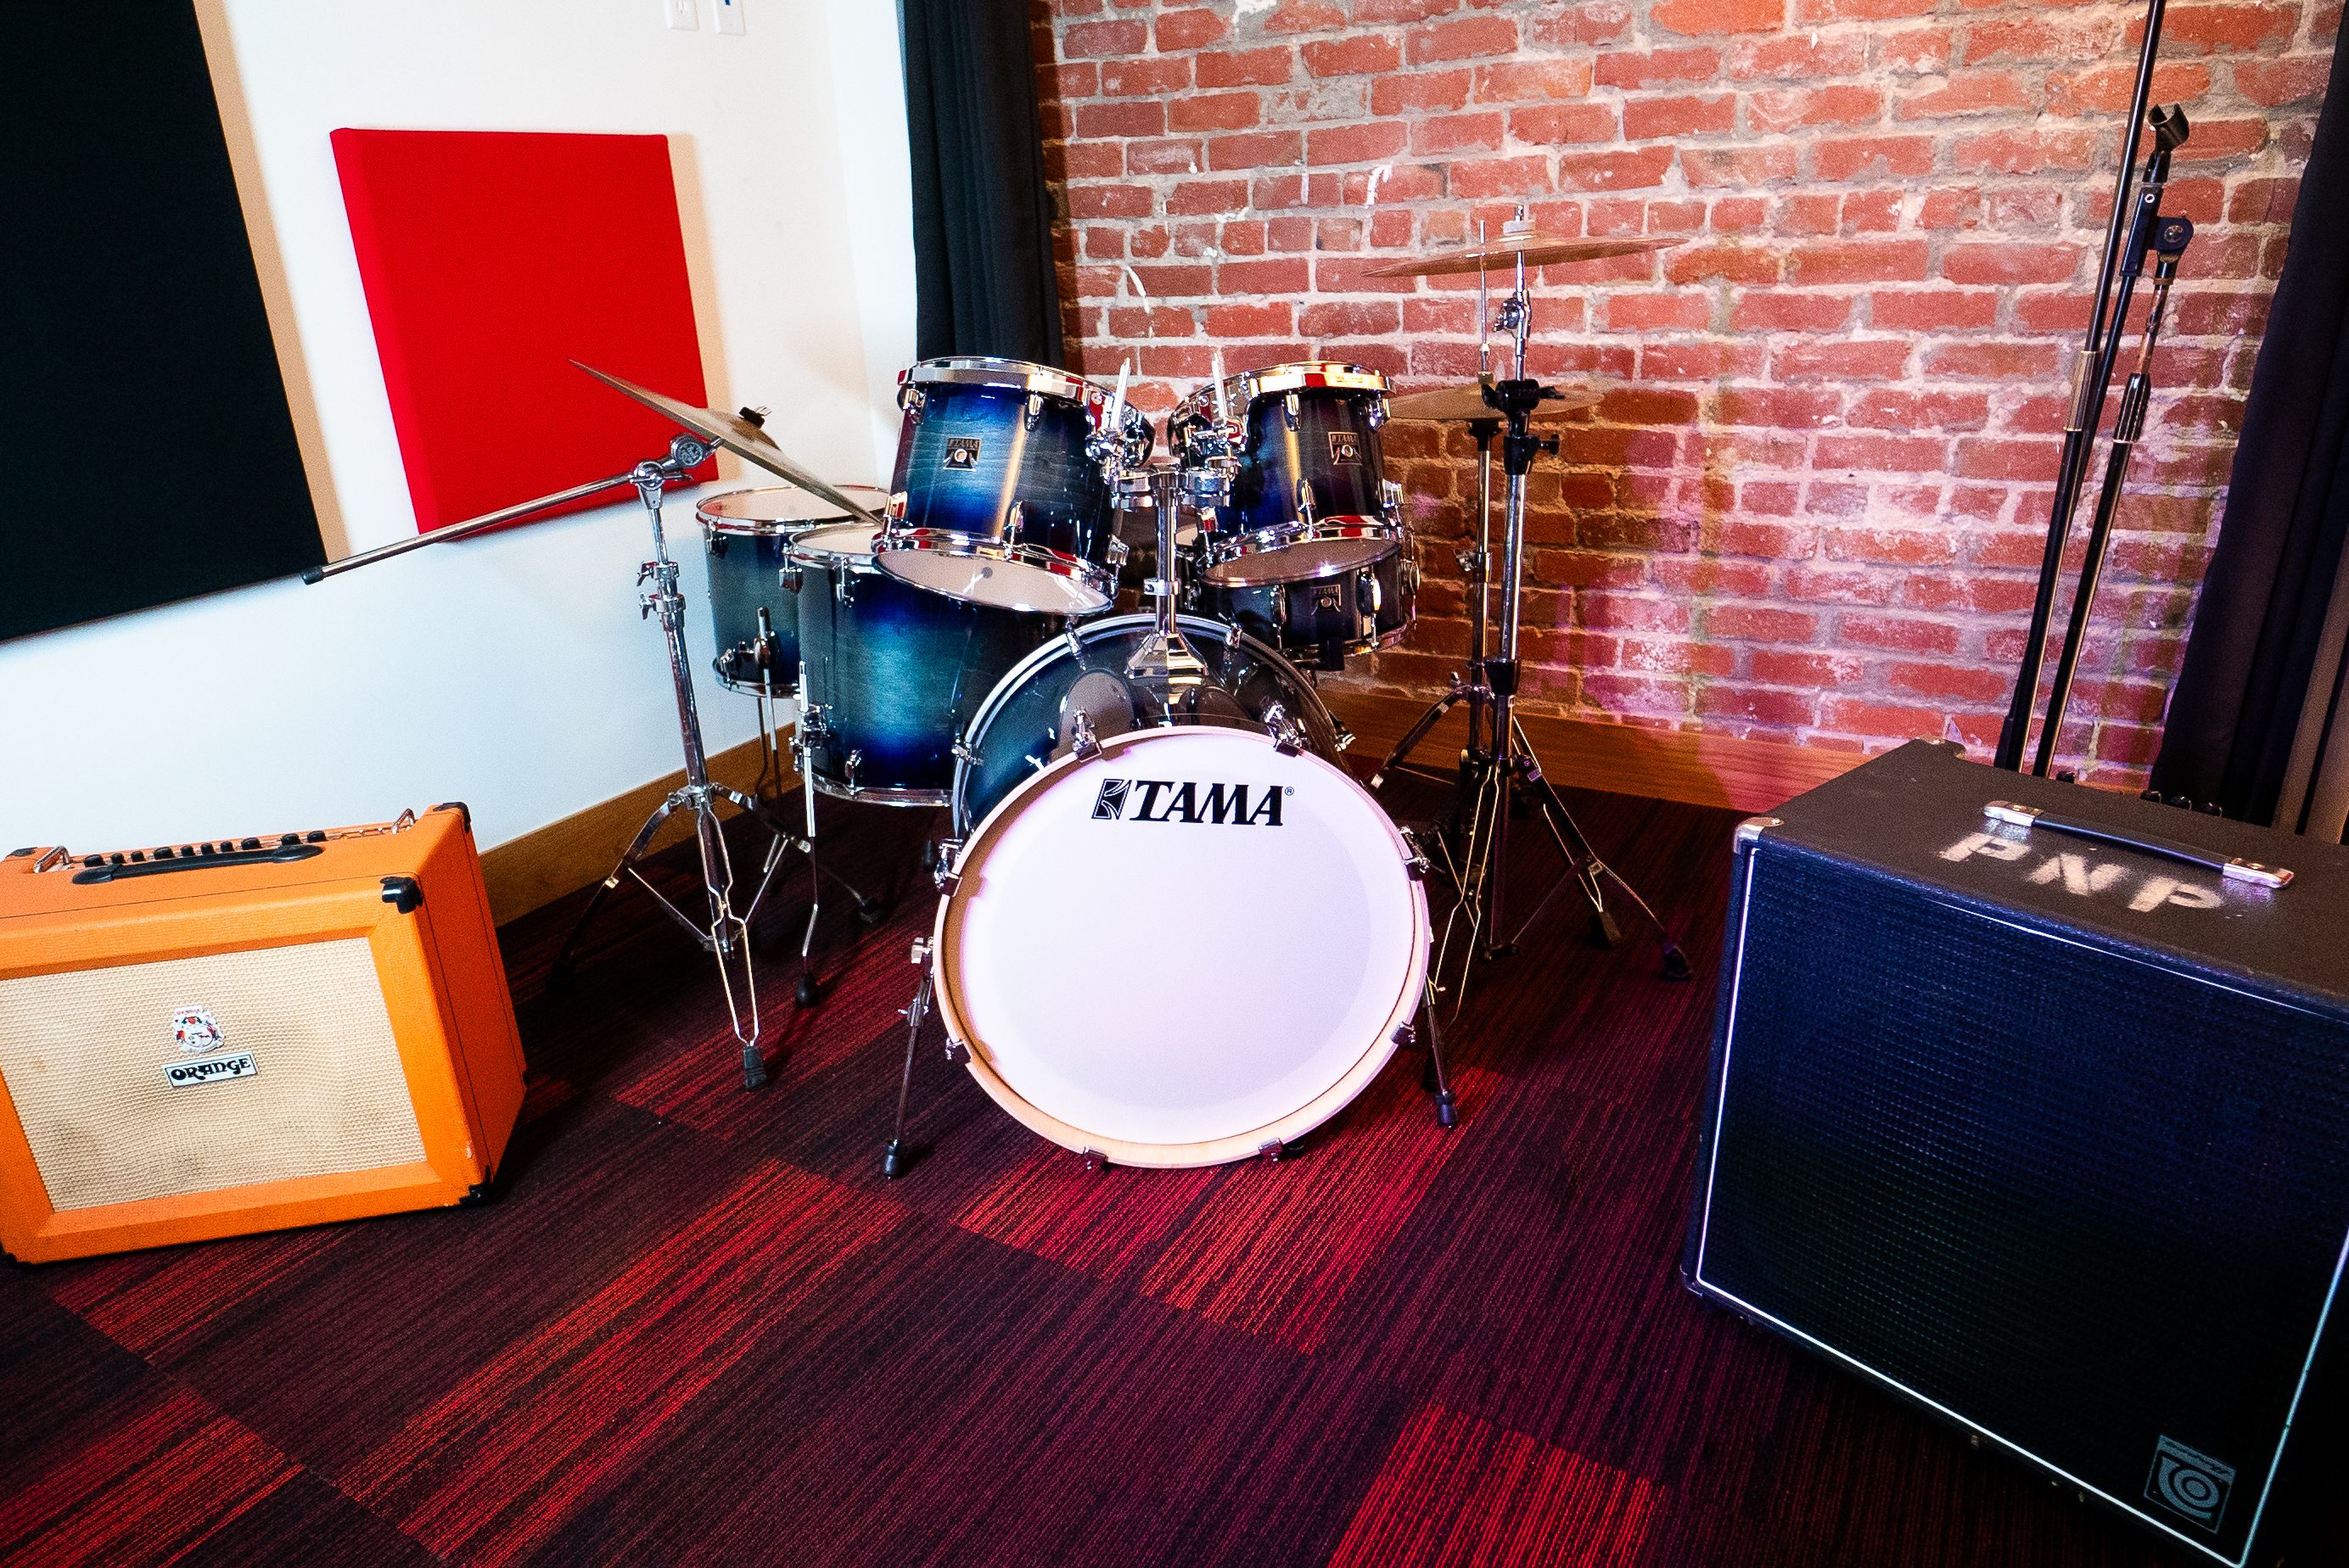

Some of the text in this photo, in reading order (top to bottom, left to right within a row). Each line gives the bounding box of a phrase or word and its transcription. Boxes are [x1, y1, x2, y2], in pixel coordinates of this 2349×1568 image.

[1130, 780, 1284, 826] TAMA
[1937, 832, 2224, 913] PNP
[171, 1057, 251, 1080] ORANGE
